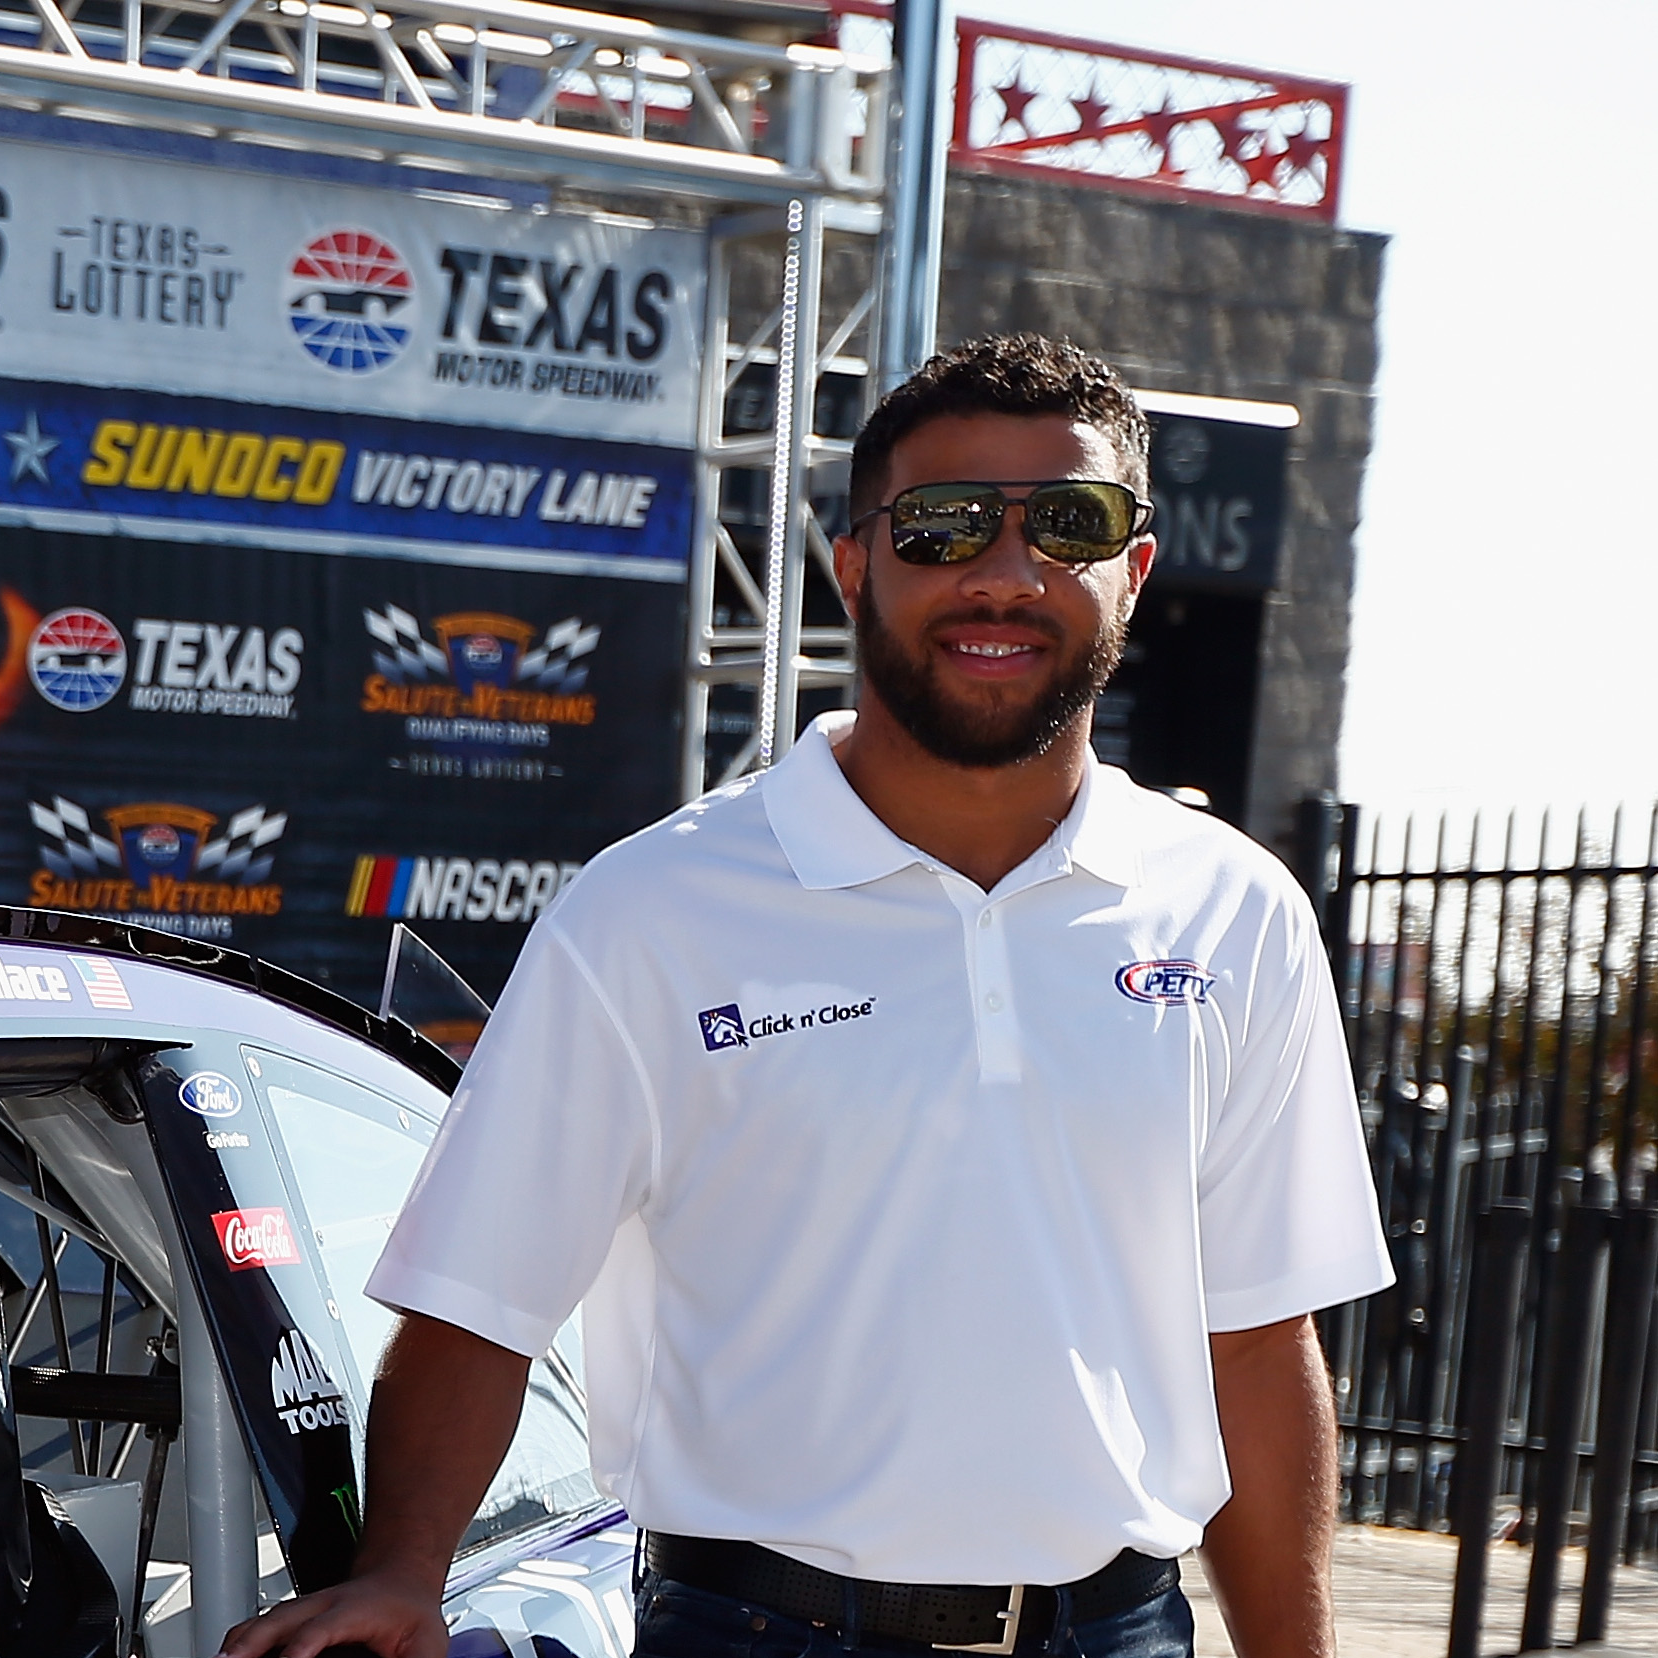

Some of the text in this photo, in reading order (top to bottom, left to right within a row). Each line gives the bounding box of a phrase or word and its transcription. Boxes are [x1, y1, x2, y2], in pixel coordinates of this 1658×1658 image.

[90, 217, 199, 267] TEXAS
[53, 250, 237, 329] LOTTERY
[440, 248, 674, 364] TEXAS
[434, 353, 523, 392] MOTOR
[83, 419, 347, 506] SUNOCO
[353, 450, 541, 517] VICTORY
[538, 469, 658, 529] LANE
[133, 618, 305, 696] TEXAS
[129, 685, 199, 713] MOTOR
[361, 673, 458, 718] SALUTE
[29, 868, 283, 916] SALUTE VETERANS
[1144, 972, 1216, 997] PETTY
[749, 1013, 795, 1038] Click
[819, 1002, 872, 1024] Close
[196, 1079, 234, 1111] Ford
[206, 1133, 223, 1149] Go
[225, 1208, 292, 1265] Coca-Cola
[278, 1400, 350, 1435] TOOLS
